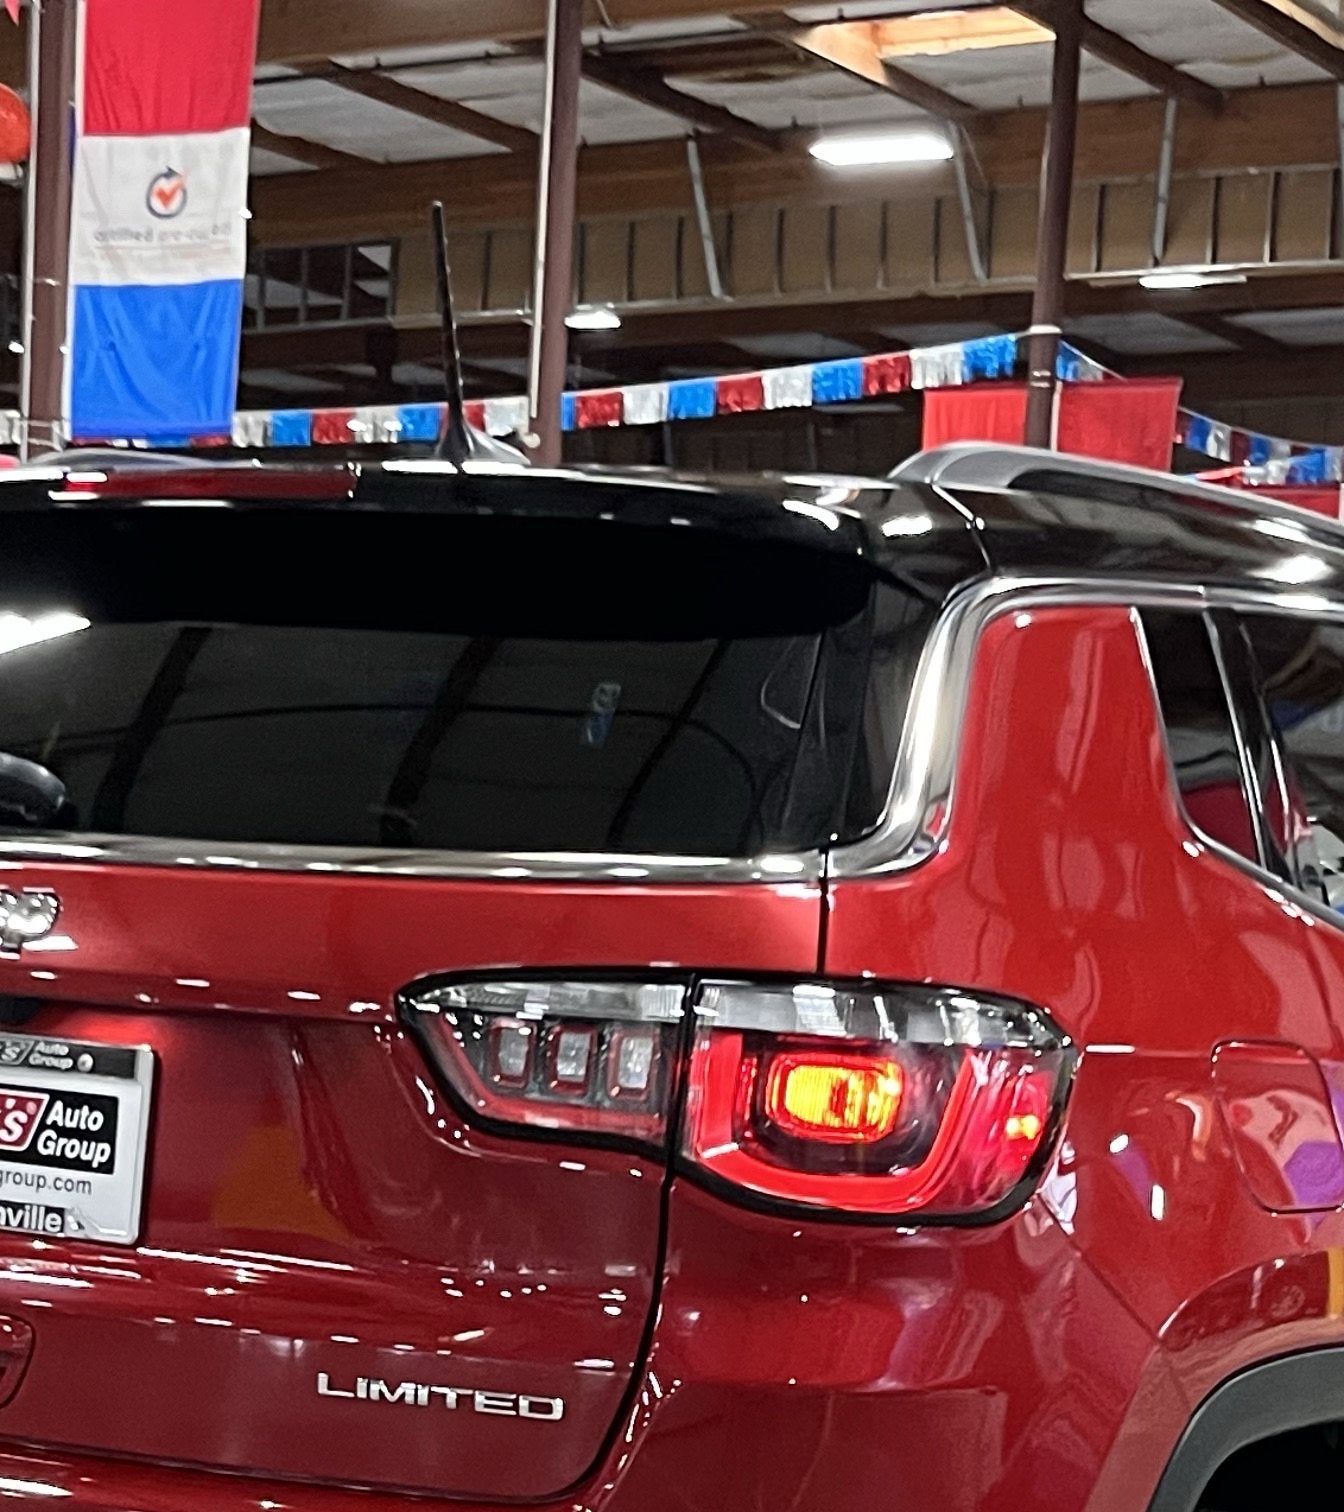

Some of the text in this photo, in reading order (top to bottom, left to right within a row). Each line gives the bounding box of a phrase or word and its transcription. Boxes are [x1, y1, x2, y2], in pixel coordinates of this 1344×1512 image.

[28, 1053, 75, 1070] Group
[34, 1041, 70, 1056] Auto
[46, 1100, 104, 1131] Auto
[37, 1129, 111, 1168] Group
[316, 1372, 564, 1421] LIMITED
